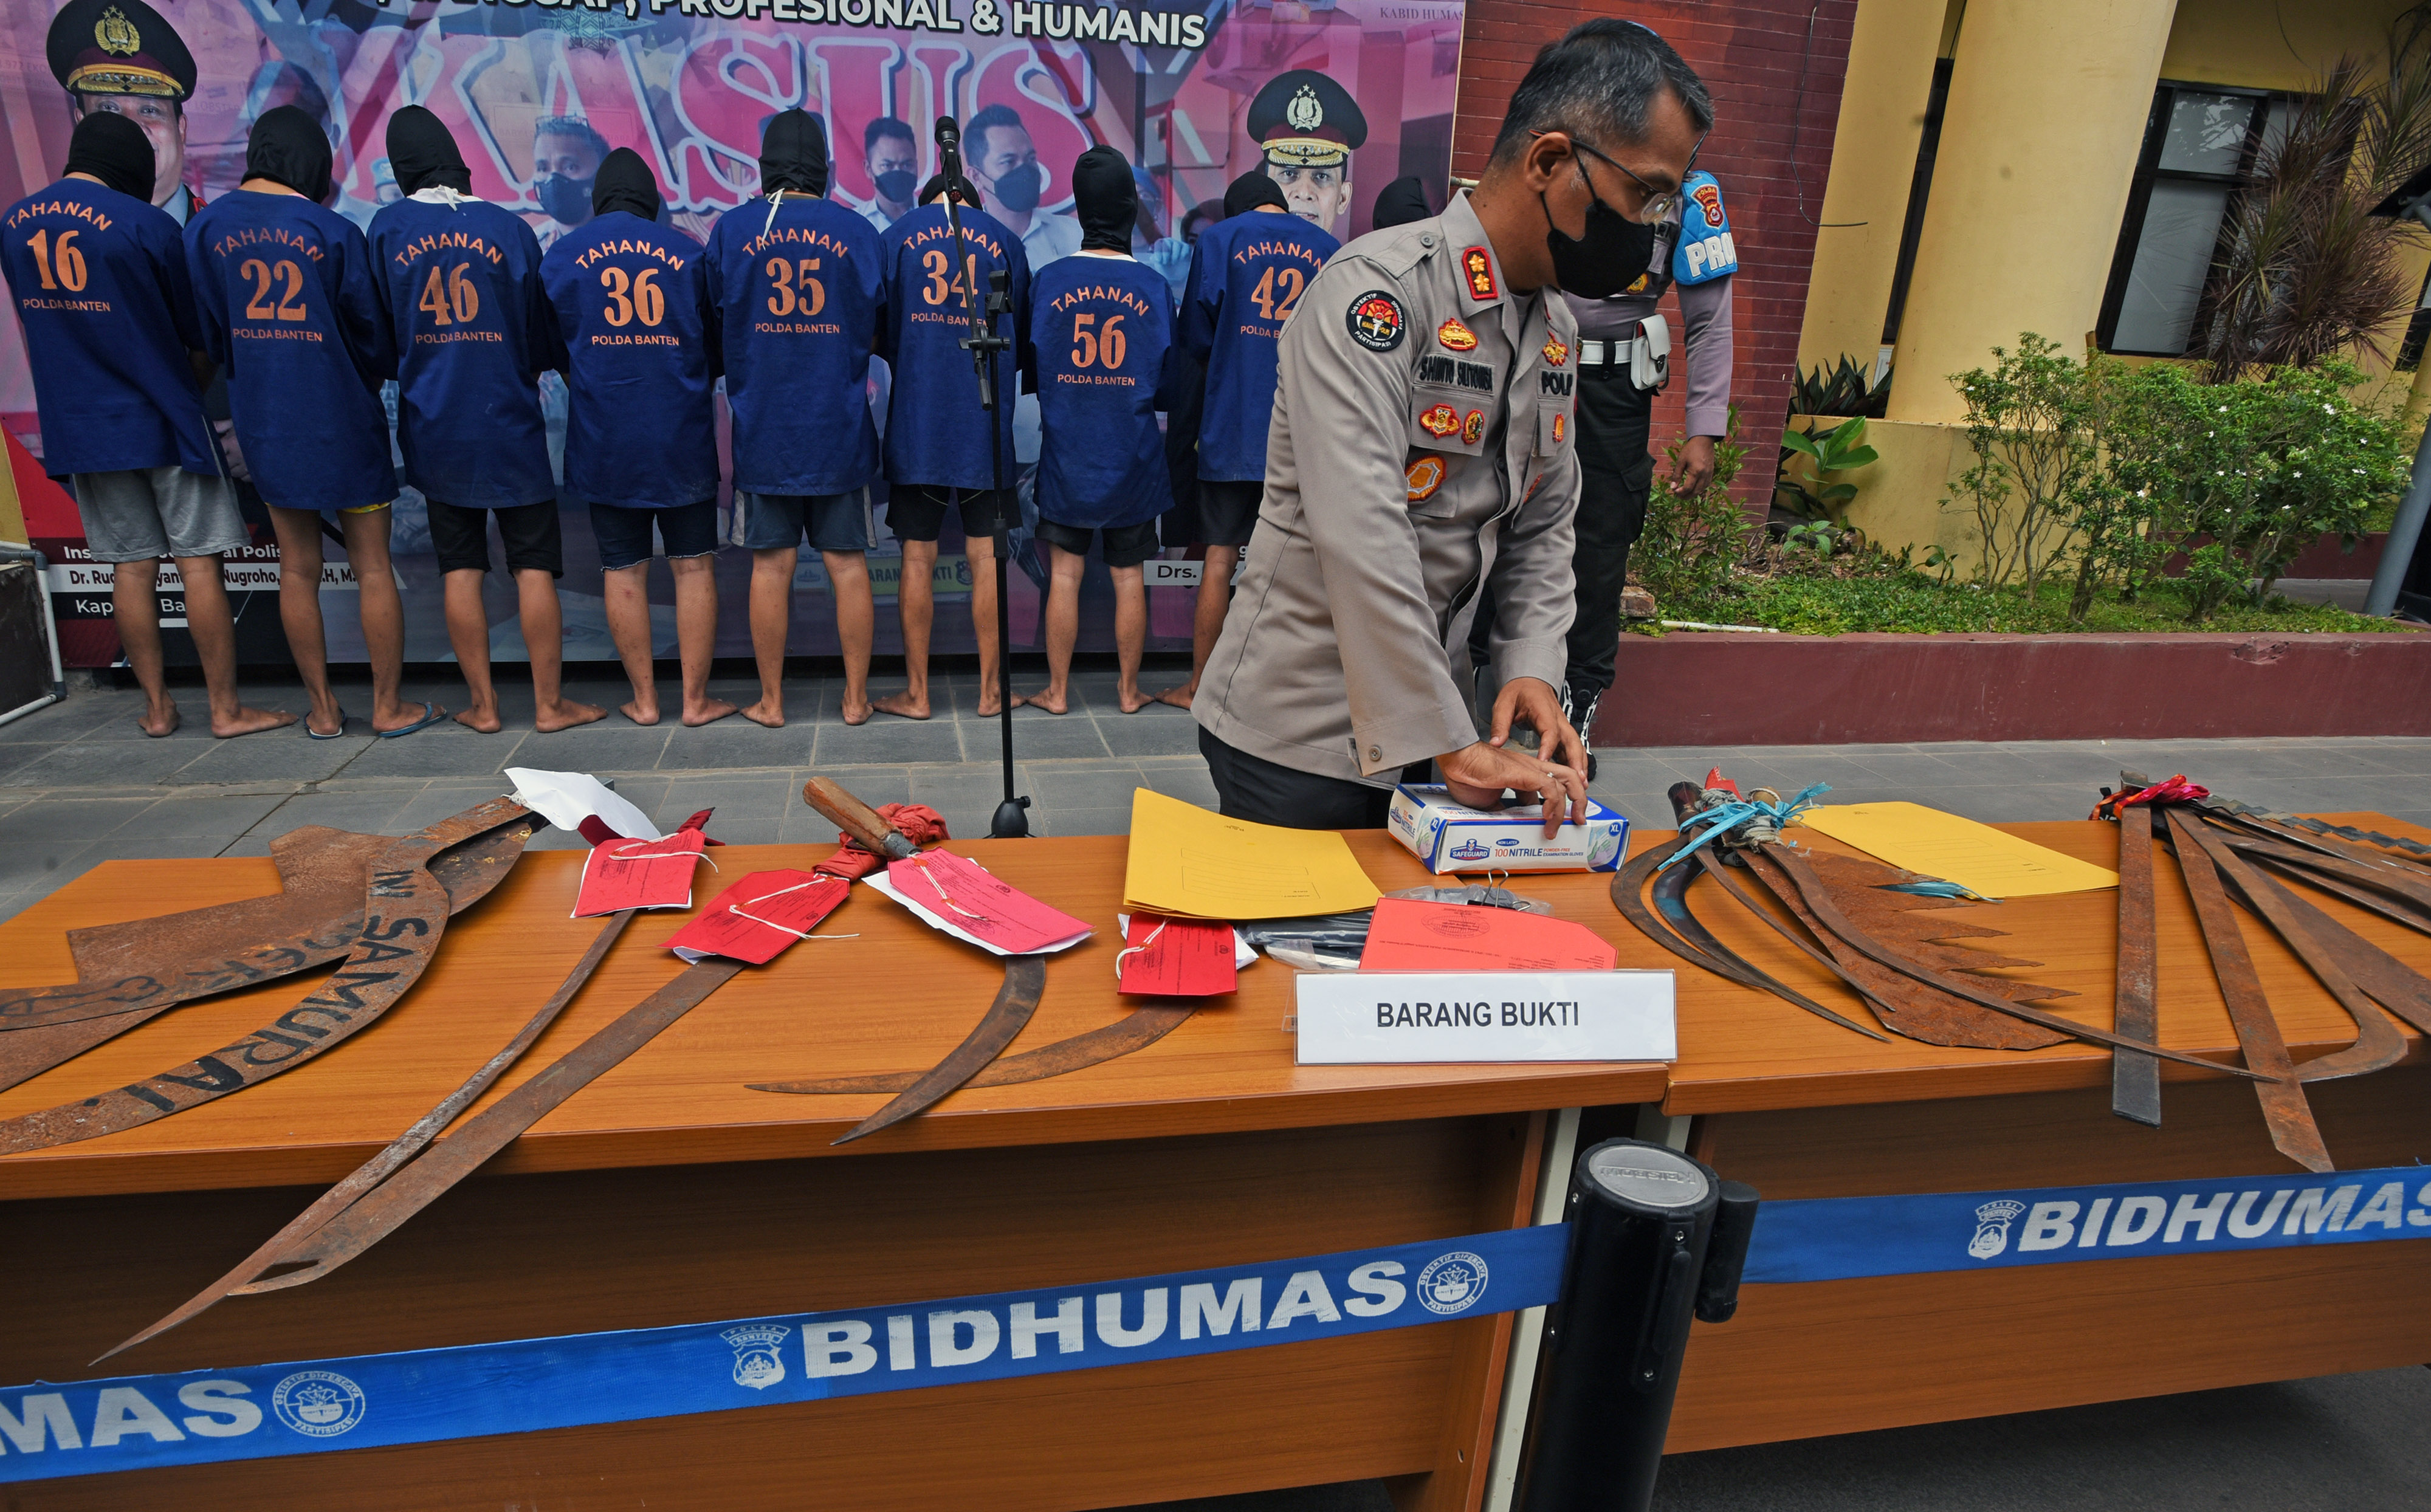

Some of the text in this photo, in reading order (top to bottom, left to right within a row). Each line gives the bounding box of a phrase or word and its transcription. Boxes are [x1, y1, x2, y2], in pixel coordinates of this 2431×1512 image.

[972, 0, 1000, 32] &
[1013, 2, 1205, 47] HUMANIS
[1380, 7, 1463, 21] KABID HUMAS
[1697, 187, 1716, 197] POLDA
[7, 201, 112, 232] TAHANAN
[215, 228, 325, 262] TAHANAN
[395, 232, 503, 266] TAHANAN
[743, 228, 848, 258] TAHANAN
[904, 225, 1002, 259] TAHANAN
[27, 229, 87, 292] 16
[576, 239, 684, 271] TAHANAN
[241, 259, 306, 321] 22
[766, 257, 825, 316] 35
[923, 250, 978, 308] 34
[23, 298, 111, 312] POLDA BANTEN
[419, 263, 479, 325] 46
[600, 266, 665, 327] 36
[1051, 286, 1149, 317] TAHANAN
[1251, 266, 1304, 320] 42
[1350, 293, 1377, 314] OBYEKTIF
[912, 312, 988, 329] POLDA BANEN
[1391, 301, 1403, 330] DIPERCAYA
[233, 328, 323, 342] POLDA BANTEN
[415, 331, 503, 345] POLDA BANTEN
[592, 335, 679, 346] POLDA BANTEN
[755, 323, 840, 334] POLDA BANTEN
[1240, 325, 1271, 337] POLDA
[1355, 331, 1392, 347] PARTISIPASI
[1071, 313, 1126, 369] 56
[1057, 373, 1135, 386] POLDA BANTEN
[64, 546, 92, 560] Ins
[69, 570, 90, 584] Dr.
[868, 566, 952, 582] ARAN KTI
[1157, 565, 1197, 579] Drs.
[75, 599, 186, 616] Kap Ba
[1431, 818, 1439, 829] XL
[1610, 824, 1619, 833] XL
[1495, 848, 1543, 857] 100 NITRILE
[1377, 1001, 1580, 1028] BARANG BUKTI
[2018, 1182, 2431, 1252] BIDHUMAS
[1428, 1296, 1475, 1312] PARTISIPASI
[802, 1261, 1407, 1379] BIDHUMAS
[0, 1380, 262, 1455] MAS
